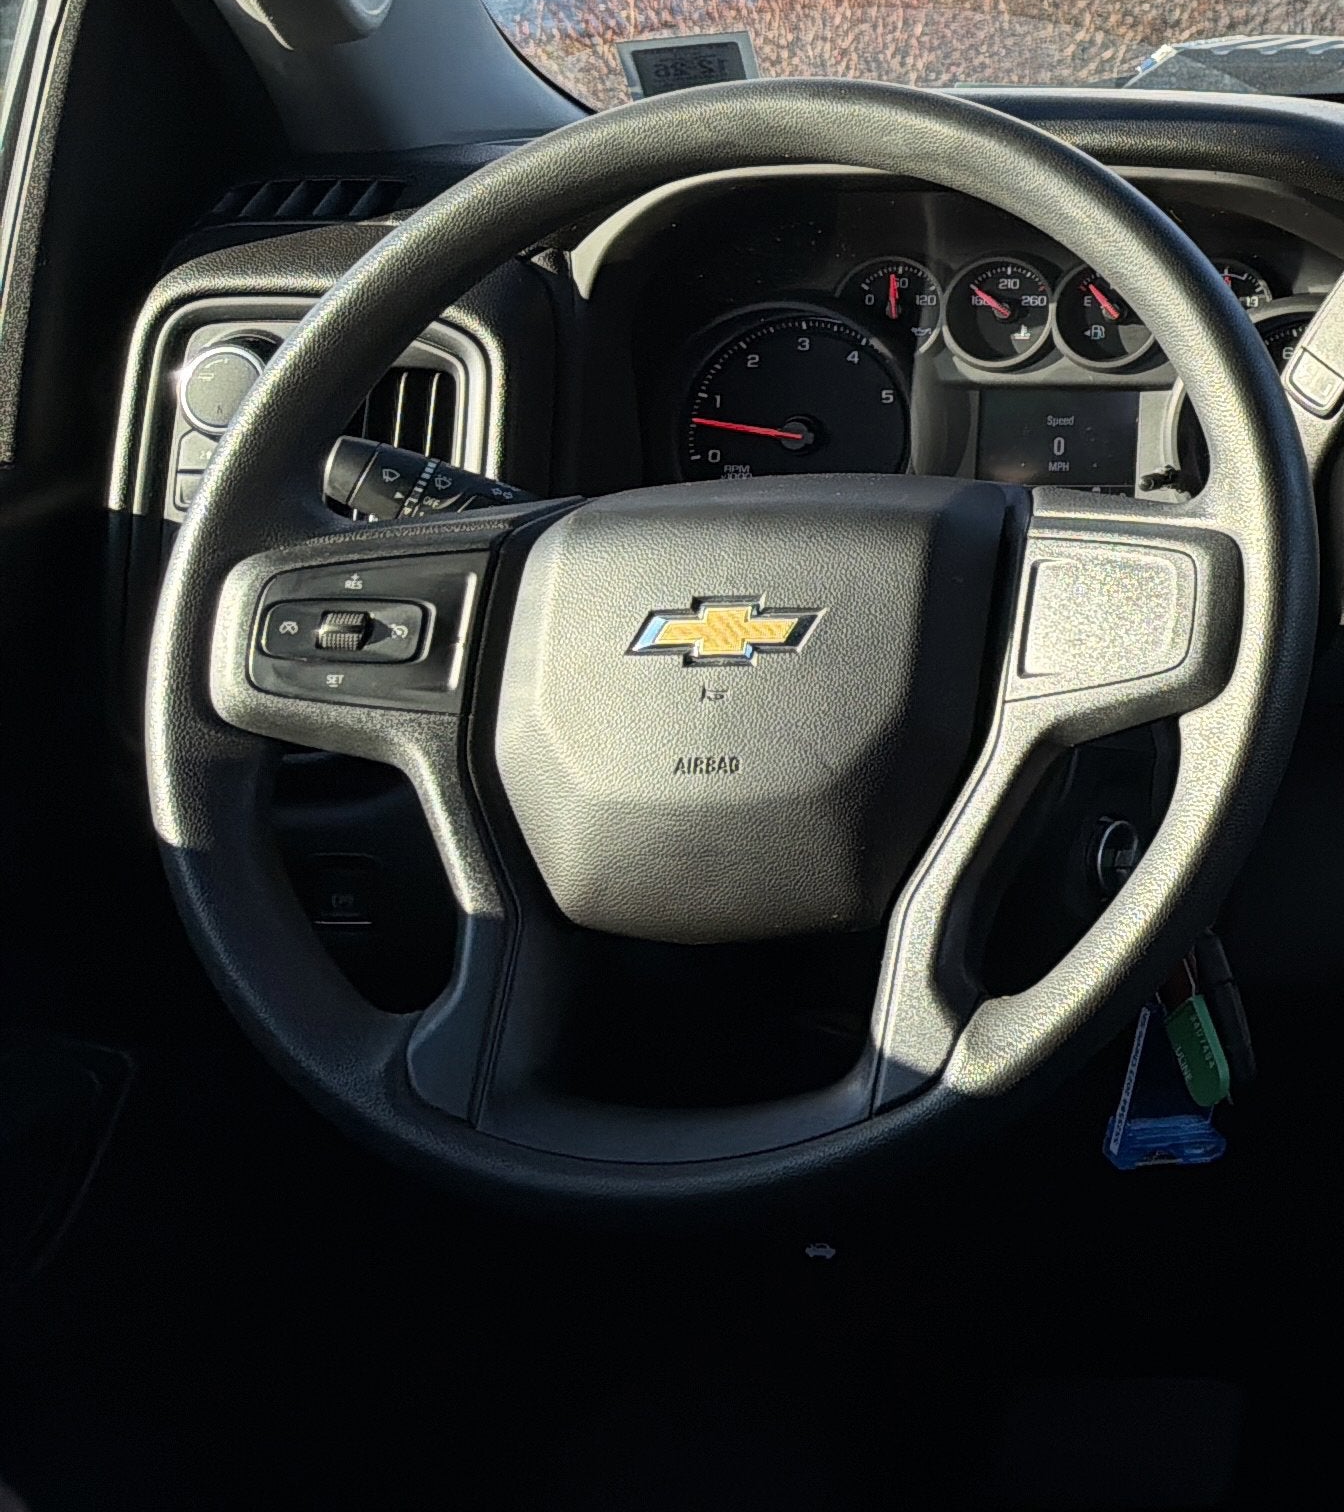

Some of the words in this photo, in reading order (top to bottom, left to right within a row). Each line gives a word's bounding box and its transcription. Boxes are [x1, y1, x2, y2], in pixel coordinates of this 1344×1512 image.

[998, 278, 1020, 290] 210
[865, 294, 875, 306] 0
[915, 294, 937, 306] 120
[1021, 296, 1047, 306] 260
[1083, 296, 1092, 307] E
[797, 338, 811, 352] 3
[747, 354, 761, 368] 2
[846, 350, 860, 365] 4
[713, 393, 721, 408] 1
[881, 389, 895, 404] 5
[1047, 414, 1074, 428] Speed
[1053, 437, 1065, 456] 0
[707, 449, 721, 463] 0
[724, 464, 750, 473] RPM
[1048, 461, 1070, 473] MPH
[345, 579, 364, 590] RES
[326, 674, 345, 685] SET
[673, 756, 741, 776] AIRBAG
